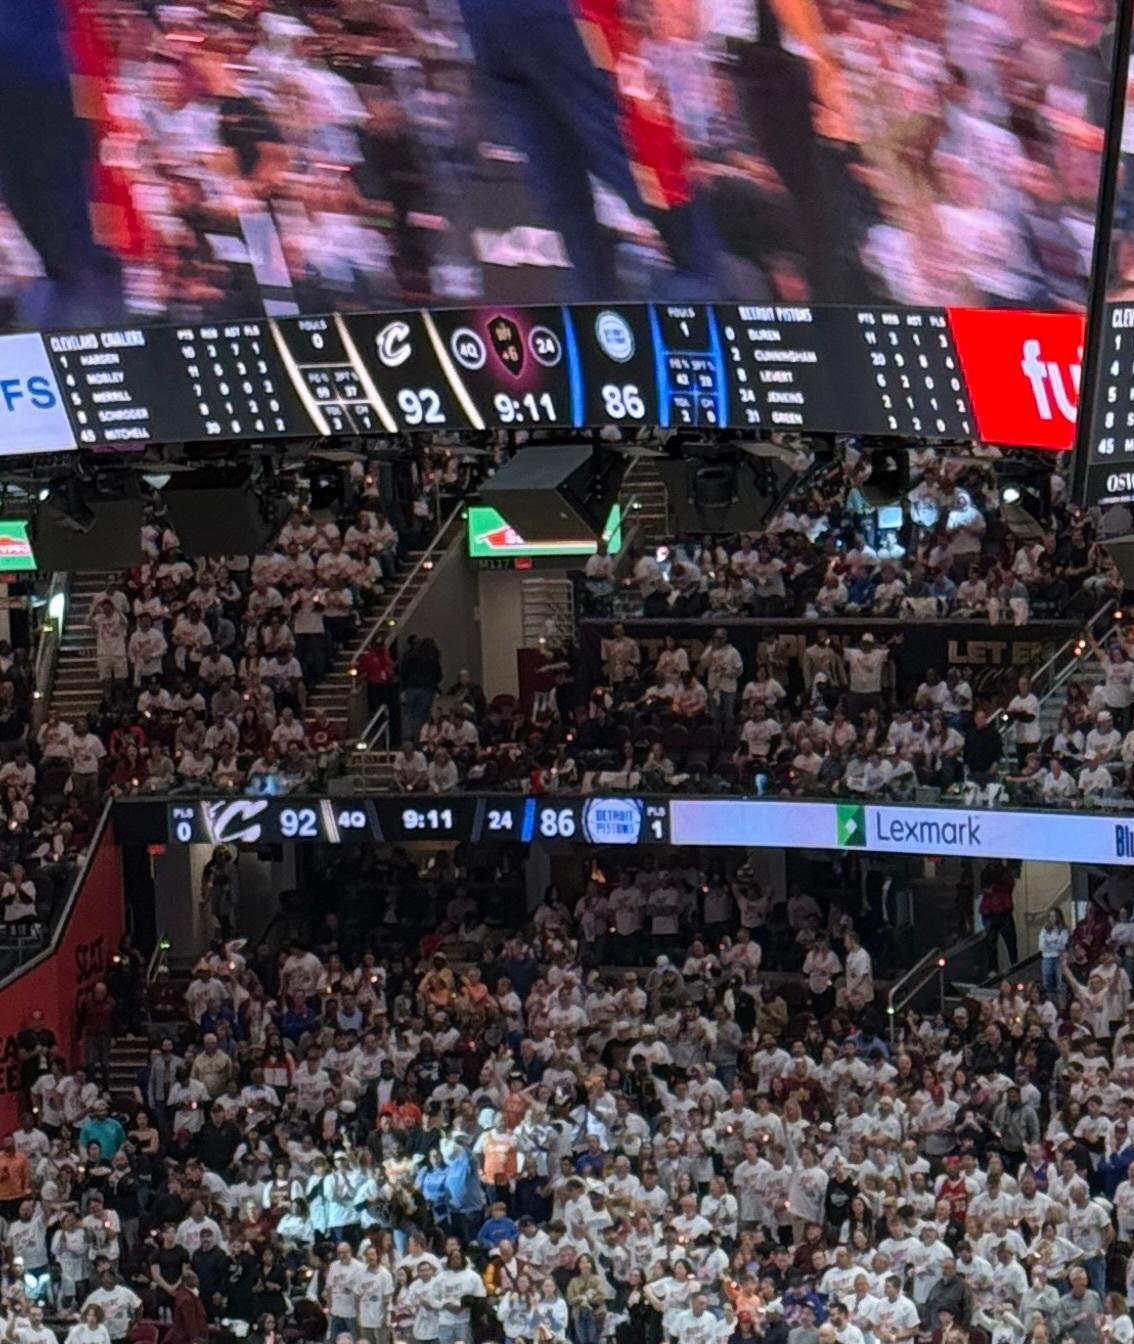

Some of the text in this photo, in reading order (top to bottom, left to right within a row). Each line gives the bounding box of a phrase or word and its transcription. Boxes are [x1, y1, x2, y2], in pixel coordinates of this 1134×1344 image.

[536, 339, 555, 355] 24
[1115, 335, 1121, 350] 1
[1111, 361, 1119, 375] 4
[1108, 387, 1116, 402] 5
[398, 384, 646, 425] 92 9:11 86
[1098, 438, 1114, 454] 45
[280, 809, 318, 837] 92
[402, 808, 453, 830] 9:11
[488, 809, 513, 831] 24
[540, 808, 576, 838] 86
[651, 819, 662, 839] 1
[876, 814, 982, 846] Lexmark
[177, 822, 192, 843] 0
